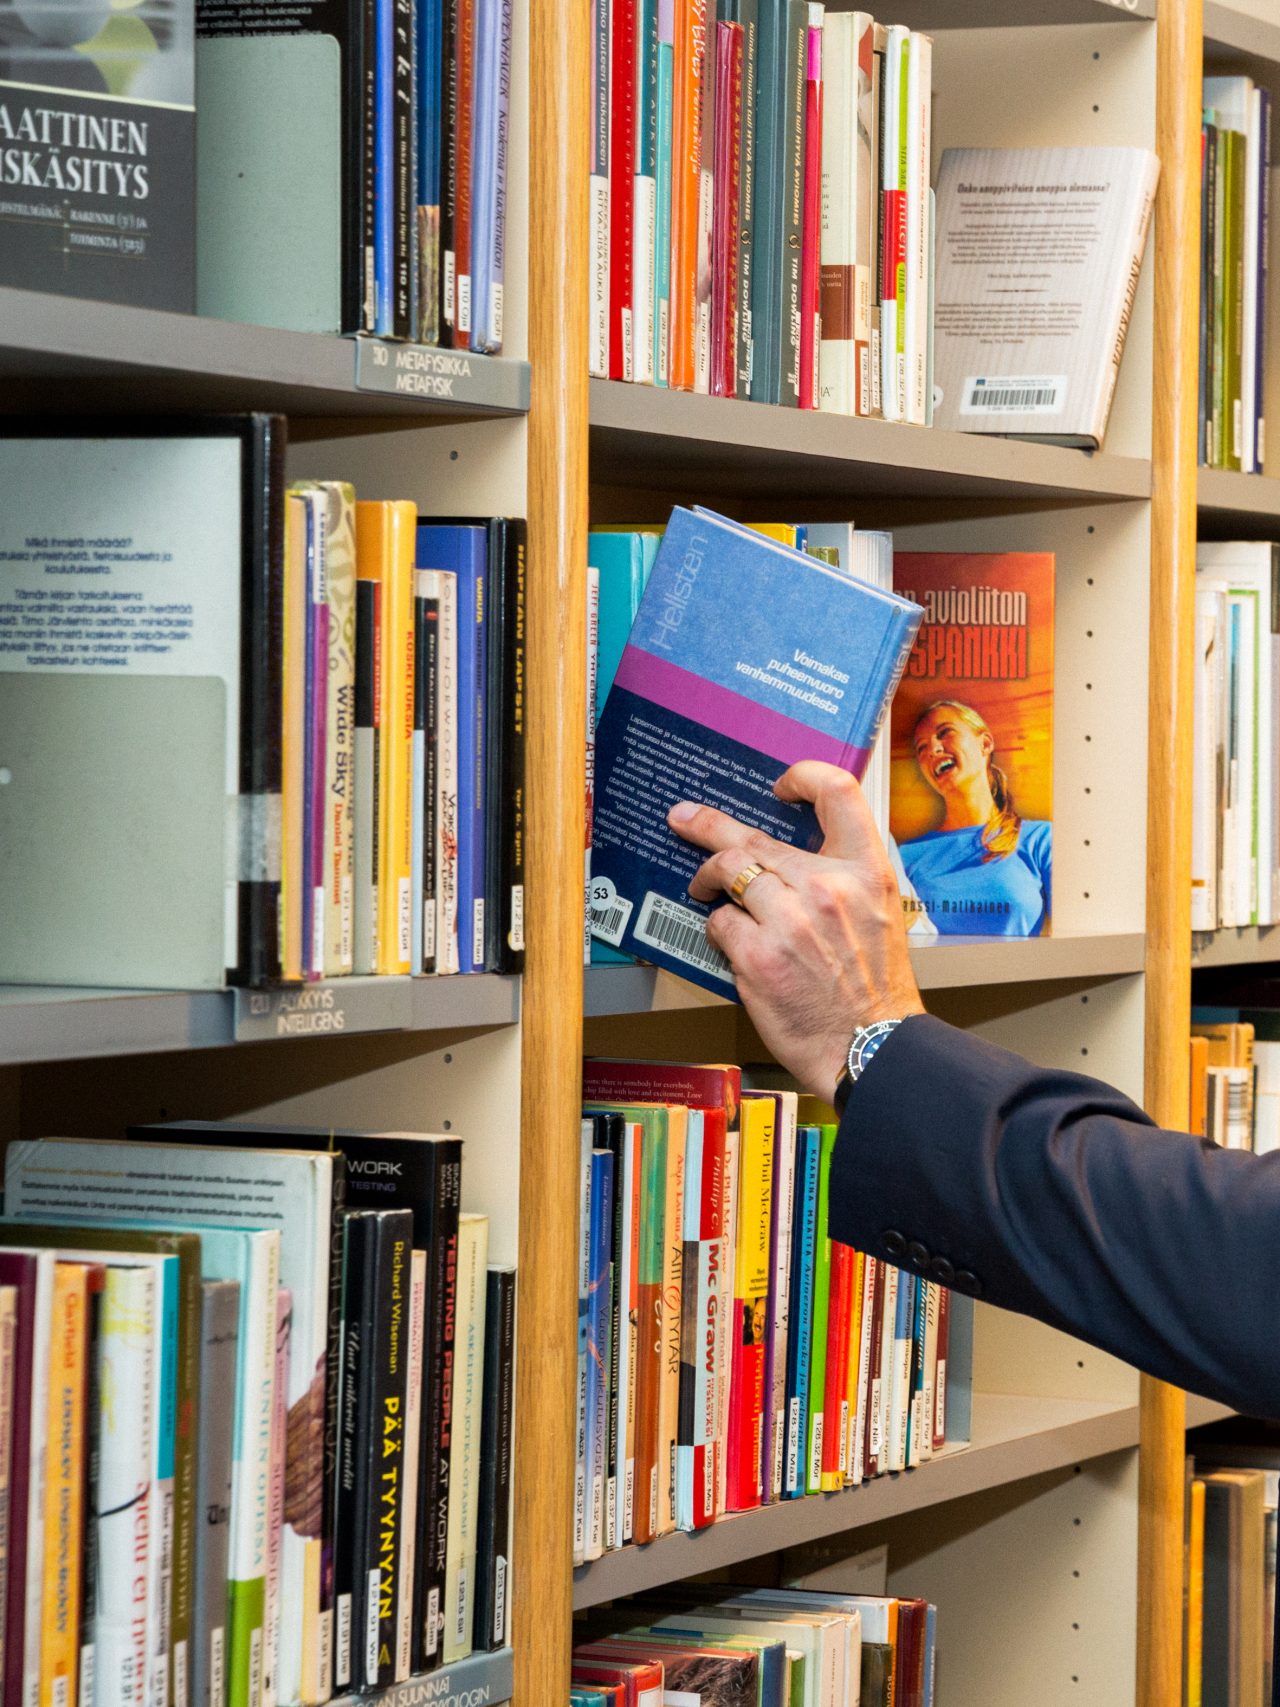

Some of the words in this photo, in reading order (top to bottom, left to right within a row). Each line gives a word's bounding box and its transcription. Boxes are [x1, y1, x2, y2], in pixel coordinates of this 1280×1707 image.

[600, 32, 608, 82] uuteen
[497, 109, 506, 170] Kuolema
[599, 86, 608, 167] rakkauteen
[743, 164, 752, 221] AVIOMIES
[793, 169, 801, 225] AVIOMIES
[493, 187, 504, 270] kuolematon
[494, 288, 502, 311] 110
[741, 280, 750, 343] DOWLING
[790, 284, 799, 346] DOWLING
[396, 374, 455, 397] METAFYSIK
[649, 535, 709, 651] Hellsten
[925, 586, 1028, 627] avioliiton
[767, 658, 845, 701] puheenvuoro
[794, 648, 851, 685] Voimakas
[906, 626, 1028, 680] SPANKKI
[404, 631, 415, 741] KOSKETUKSIA
[514, 648, 524, 735] LAPSET
[735, 661, 839, 716] vanhemmuudesta
[336, 686, 350, 745] Wide
[443, 658, 451, 780] NORWOOD
[630, 713, 664, 736] Lapsemme
[331, 752, 348, 798] Sky
[637, 742, 677, 766] vanhemmuus
[683, 787, 702, 803] mutta
[334, 803, 343, 847] Daniel
[592, 886, 609, 901] 53
[661, 908, 698, 929] HELSINGFORS
[663, 901, 693, 919] HELSINGIN
[763, 1126, 774, 1147] Dr.
[347, 1160, 403, 1177] WORK
[709, 1155, 722, 1207] Phillip
[761, 1152, 771, 1182] Phil
[758, 1187, 770, 1254] McGraw
[392, 1240, 405, 1300] Richard
[444, 1234, 458, 1342] TESTING
[708, 1243, 720, 1287] Mc
[389, 1302, 402, 1375] Wiseman
[504, 1285, 514, 1347] Tammisalo
[705, 1295, 719, 1374] Graw
[440, 1350, 454, 1449] PEOPLE
[502, 1360, 512, 1411] Tavataan
[383, 1396, 403, 1459] PÄÄ
[791, 1402, 799, 1447] 128.32
[439, 1458, 450, 1488] AT
[500, 1440, 509, 1486] viikolla
[789, 1453, 797, 1483] Maa
[378, 1466, 398, 1620] TYYNYYN
[436, 1496, 449, 1572] WORK
